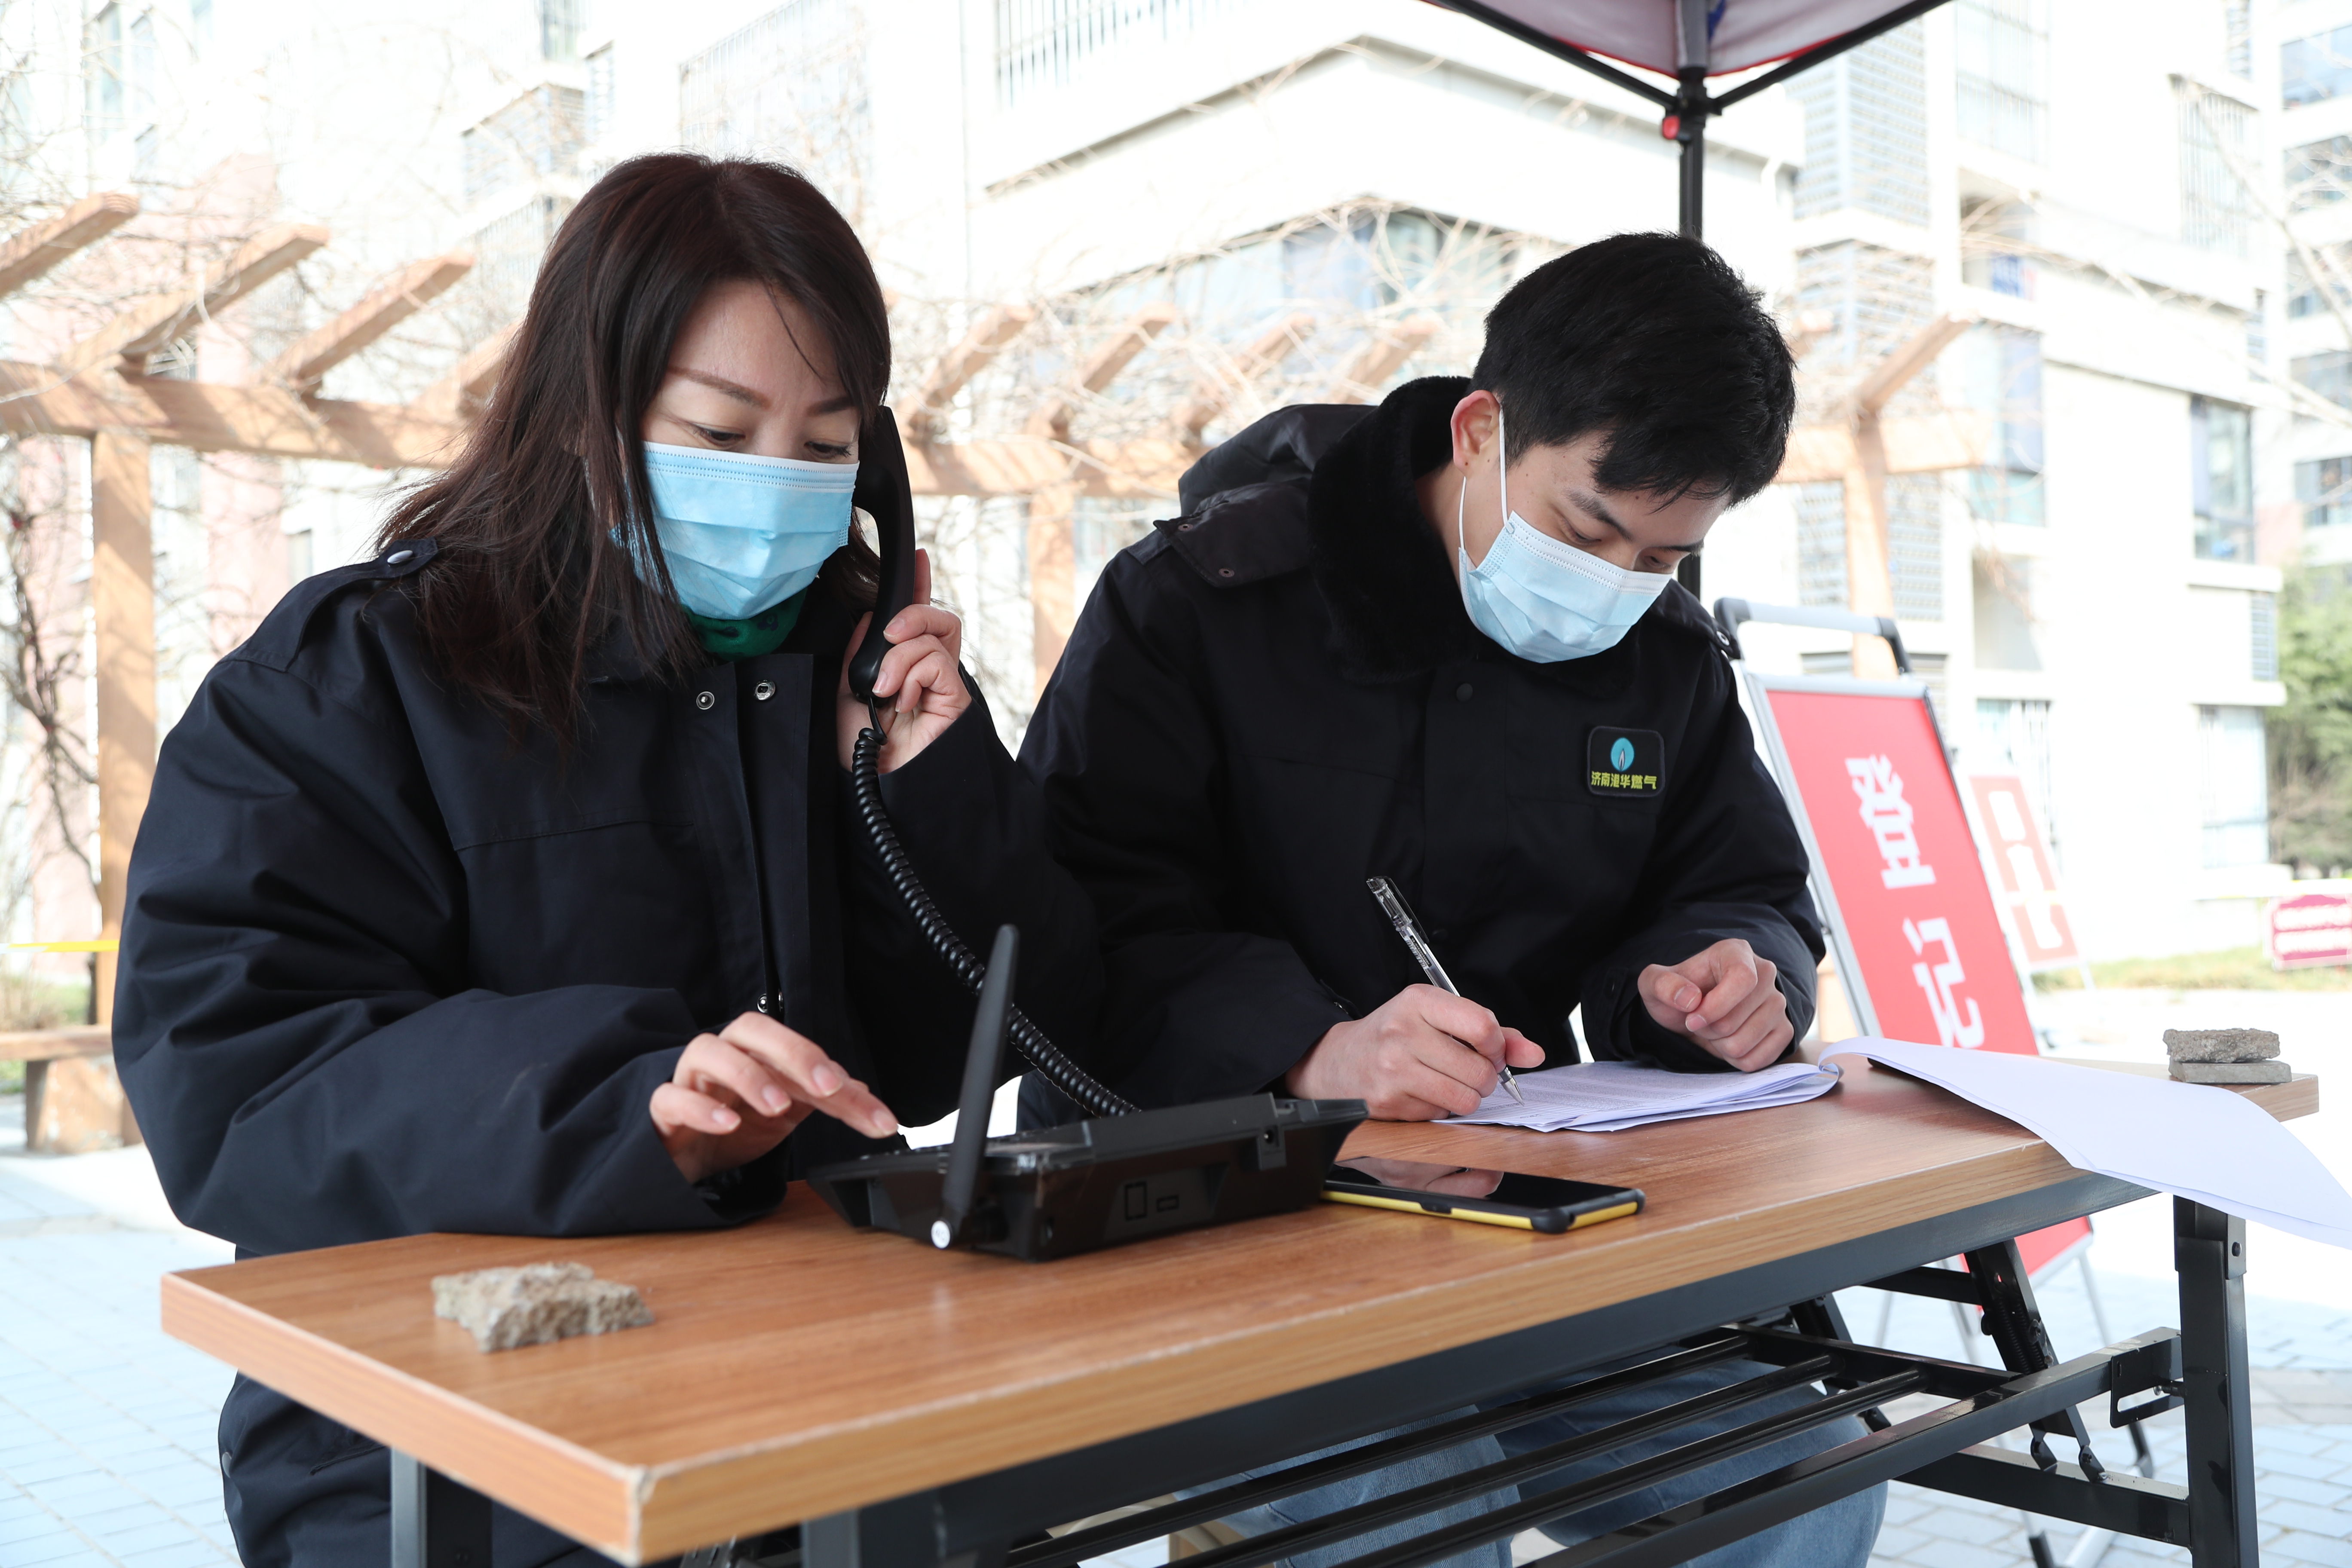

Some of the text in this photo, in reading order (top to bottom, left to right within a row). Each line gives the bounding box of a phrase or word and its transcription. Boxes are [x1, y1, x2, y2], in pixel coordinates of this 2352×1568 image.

[1591, 771, 1657, 790] 济南港华燃气
[1845, 754, 1985, 1050] 登记
